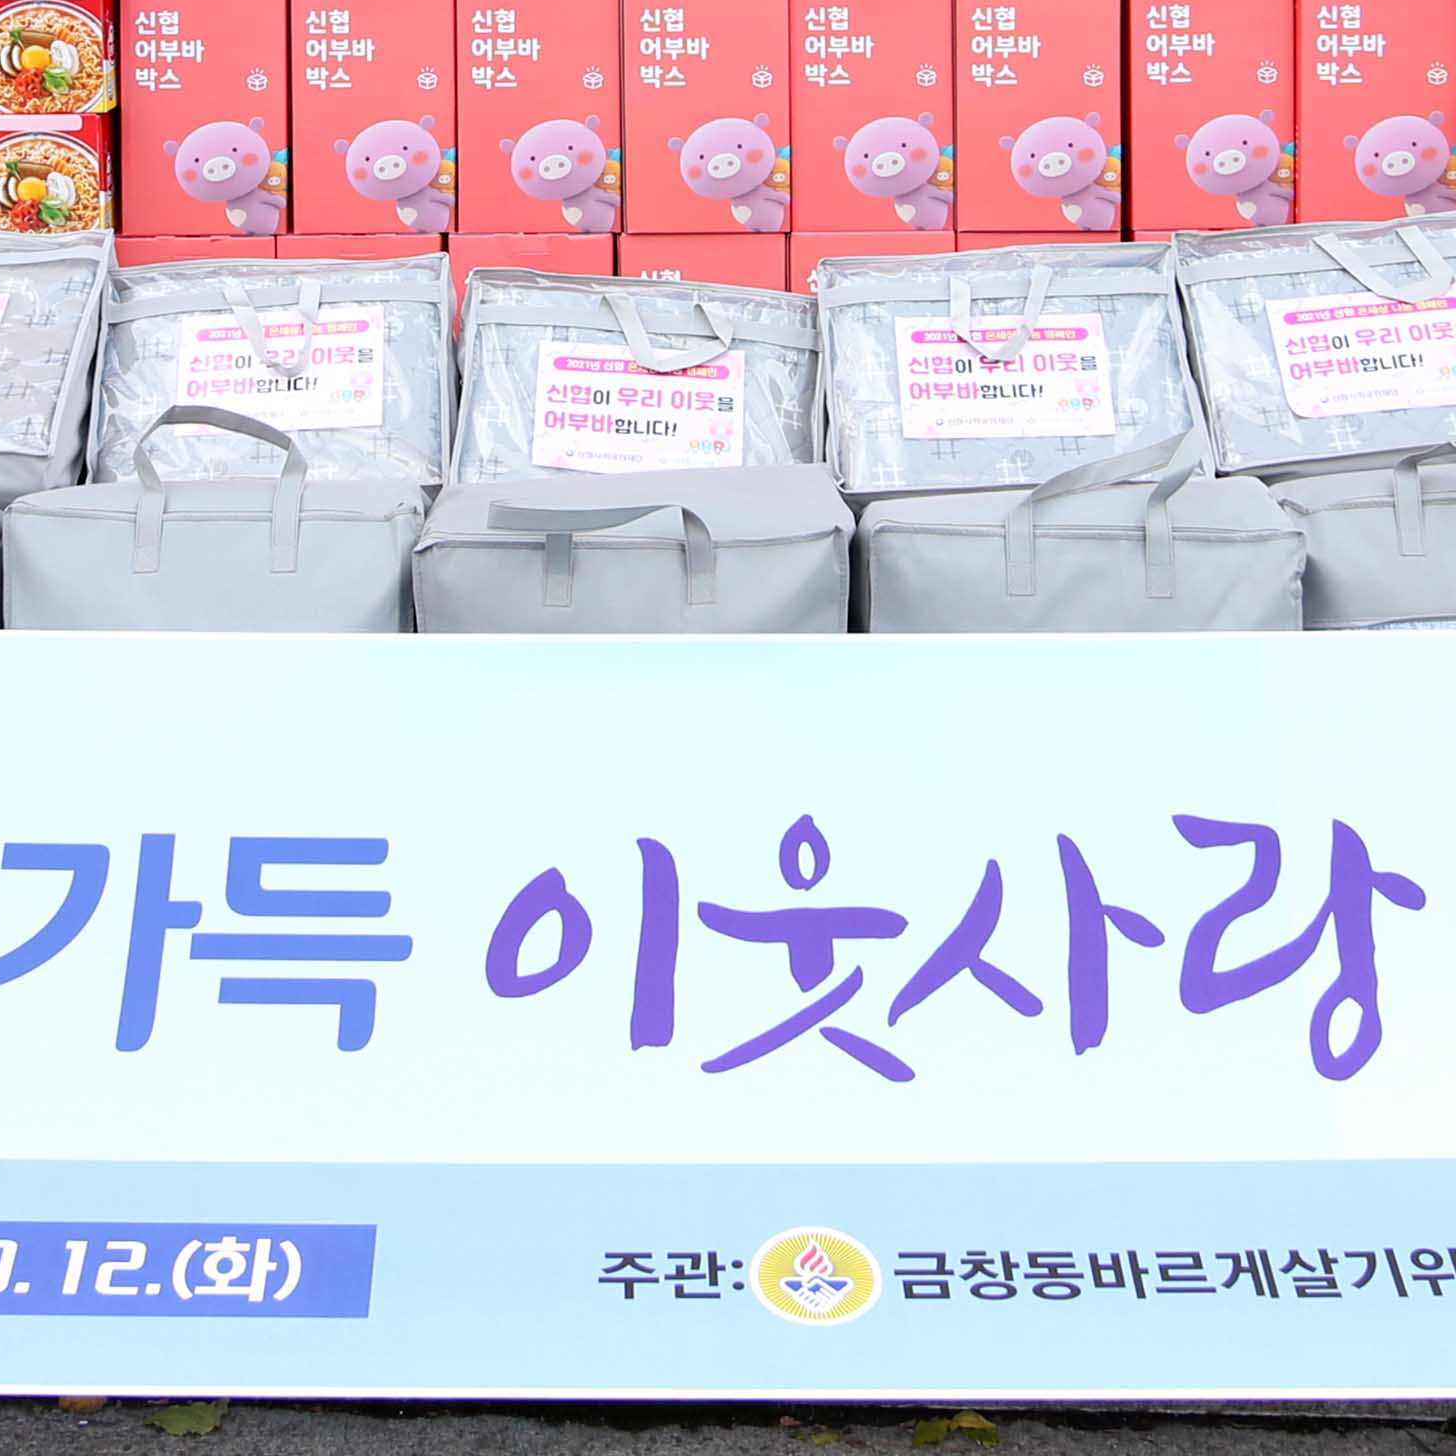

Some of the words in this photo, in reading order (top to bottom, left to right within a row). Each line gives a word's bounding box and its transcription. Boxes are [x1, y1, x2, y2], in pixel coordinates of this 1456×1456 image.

[136, 11, 178, 34] 신협
[306, 10, 349, 33] 신협
[472, 9, 515, 33] 신협
[640, 8, 683, 32] 신협
[805, 6, 848, 30] 신협
[972, 7, 1015, 30] 신협
[1147, 4, 1189, 28] 신협
[1317, 5, 1360, 28] 신협
[136, 40, 204, 62] 어부바
[306, 39, 375, 62] 어부바
[472, 38, 540, 61] 어부바
[640, 37, 709, 60] 어부바
[805, 36, 874, 58] 어부바
[972, 36, 1040, 58] 어부바
[1147, 33, 1215, 56] 어부바
[1317, 34, 1386, 57] 어부바
[136, 69, 181, 91] 박스
[306, 67, 351, 90] 박스
[472, 67, 517, 89] 박스
[641, 66, 686, 88] 박스
[806, 64, 850, 87] 박스
[972, 64, 1017, 87] 박스
[1147, 62, 1192, 85] 박스
[1317, 63, 1362, 85] 박스
[1285, 332, 1351, 356] 신협이
[1355, 326, 1402, 347] 우리
[908, 354, 973, 376] 신협이
[1033, 352, 1098, 373] 이웃을
[546, 383, 611, 407] 신협이
[617, 387, 664, 410] 우리
[670, 389, 735, 413] 이웃을
[543, 409, 679, 437] 어부바합니다!
[487, 815, 1425, 1082] 이웃사랑
[62, 1237, 301, 1303] 12.(화)
[597, 1252, 746, 1300] 주관:
